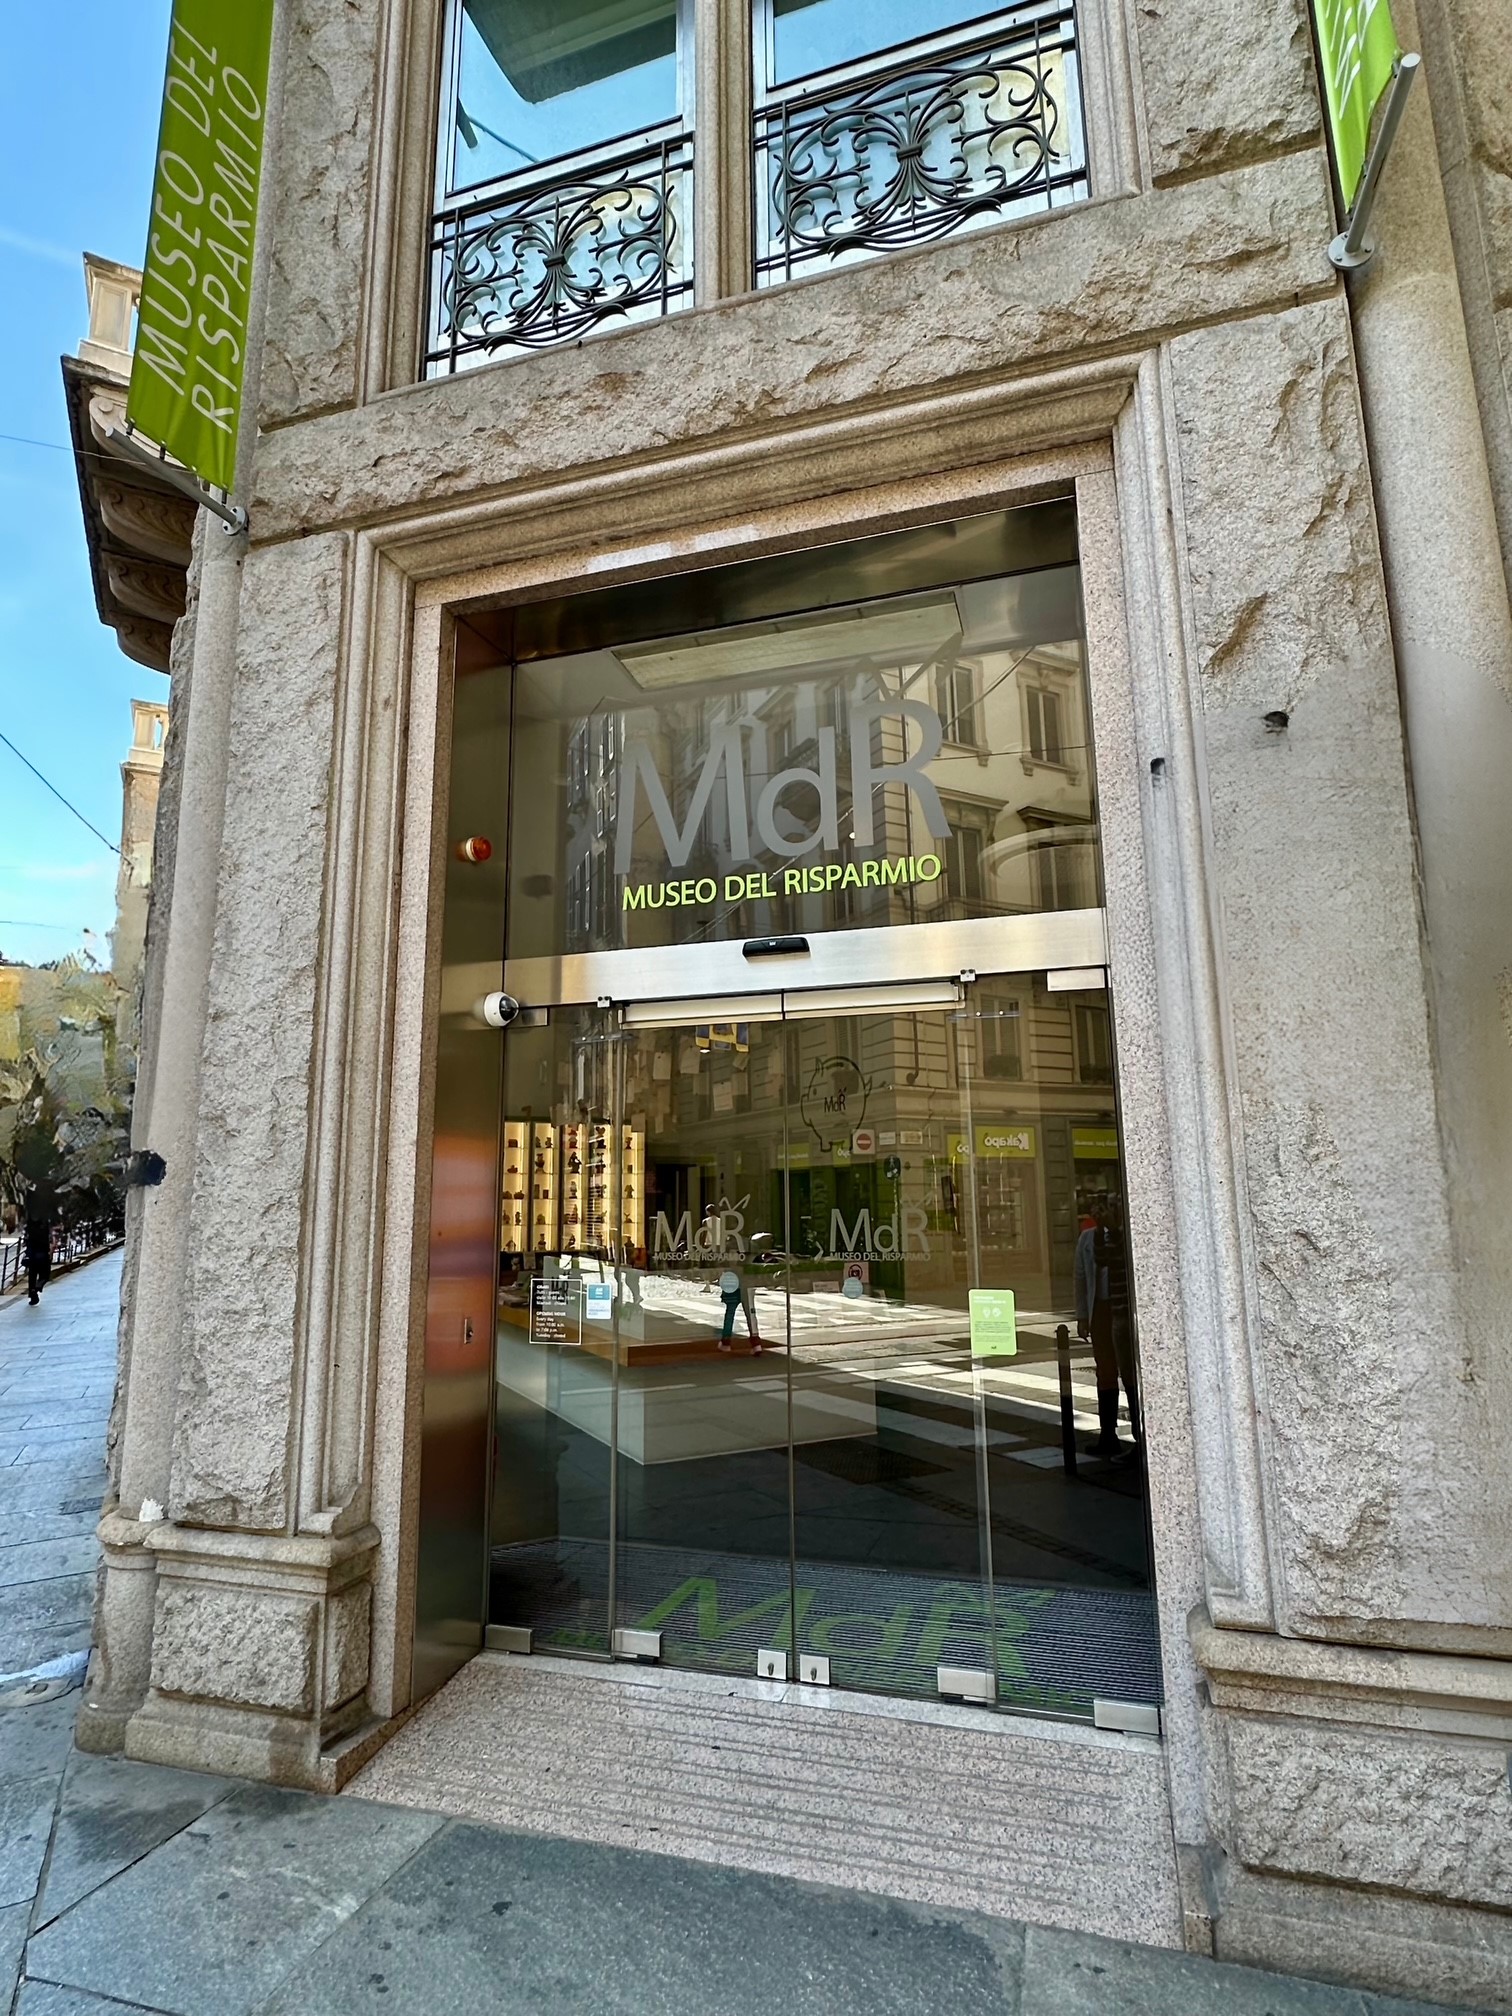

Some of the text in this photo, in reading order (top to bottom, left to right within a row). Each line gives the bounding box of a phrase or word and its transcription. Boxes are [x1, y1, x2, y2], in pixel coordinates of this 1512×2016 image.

[139, 17, 218, 396] MUSEO DEL
[191, 65, 262, 435] RISPARMIO
[613, 698, 953, 875] MdR
[622, 854, 942, 912] MUSEO DEL RISPARMIO
[824, 1093, 846, 1113] MdR
[654, 1210, 746, 1253] MdR
[829, 1208, 931, 1253] MdR
[830, 1251, 862, 1261] MUSEO
[863, 1252, 880, 1261] DEL
